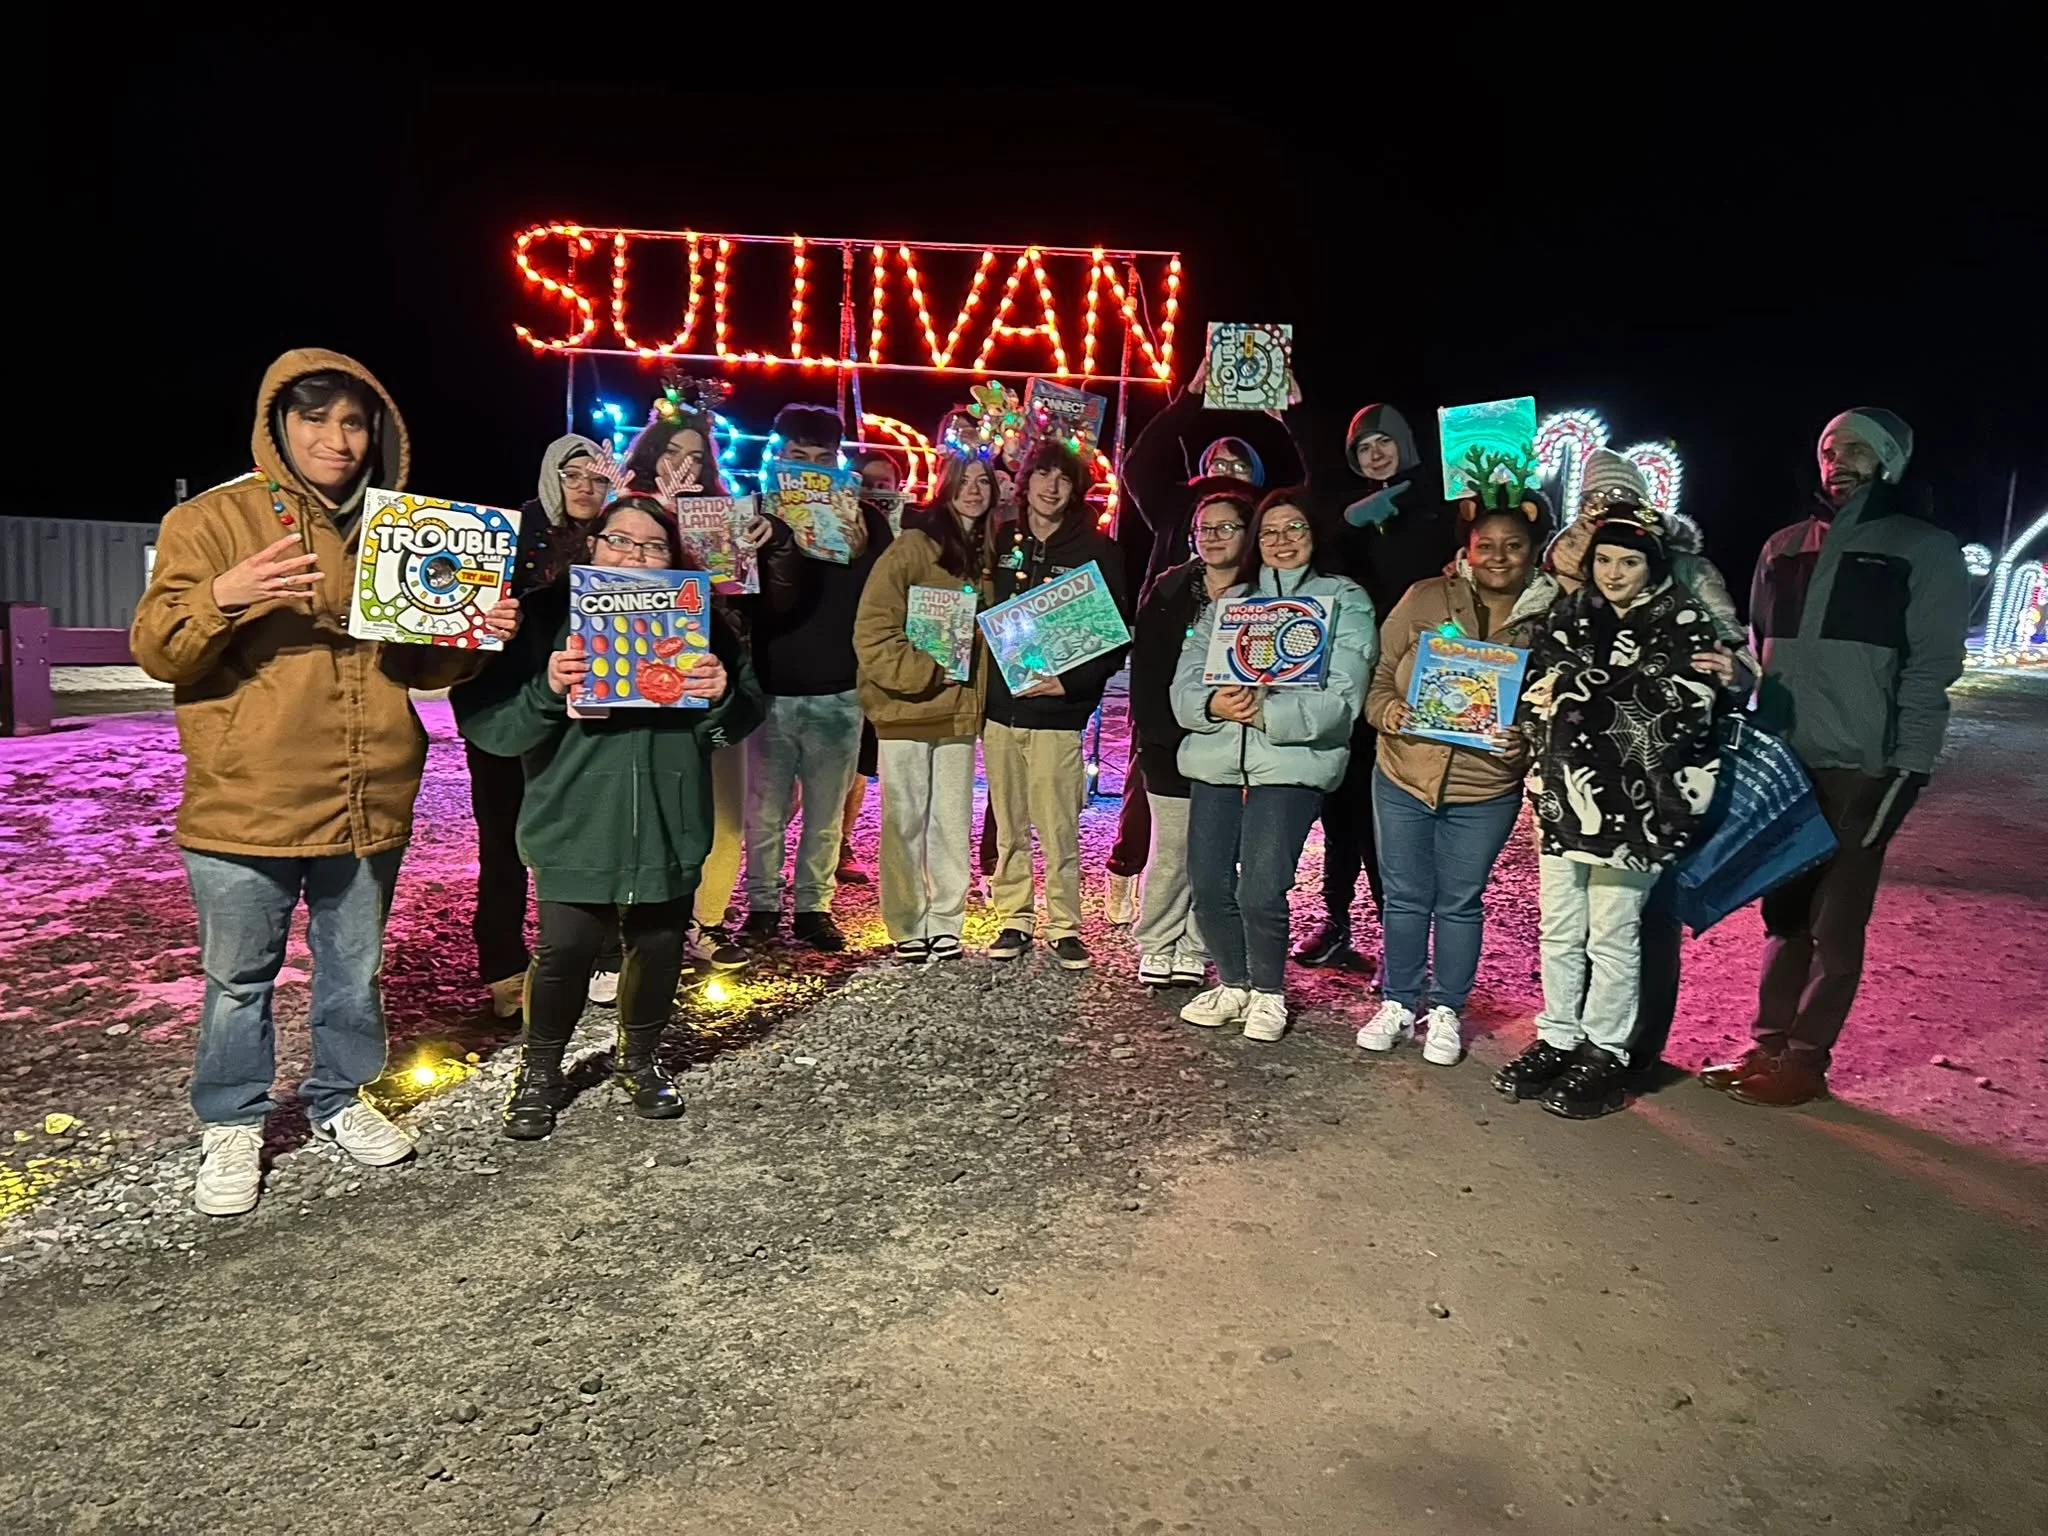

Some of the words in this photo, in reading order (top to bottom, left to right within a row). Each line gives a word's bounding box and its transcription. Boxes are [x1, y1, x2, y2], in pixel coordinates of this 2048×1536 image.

[513, 222, 1183, 383] SULLIVAN
[1220, 326, 1239, 405] TROUBLE
[681, 499, 734, 513] CANDY
[682, 514, 724, 529] LAND
[375, 525, 513, 556] TROUBLE
[461, 571, 478, 581] TRY
[580, 591, 678, 614] CONNECT
[676, 579, 700, 613] 4
[990, 573, 1092, 634] MONOPOLY
[1228, 605, 1265, 614] WORD
